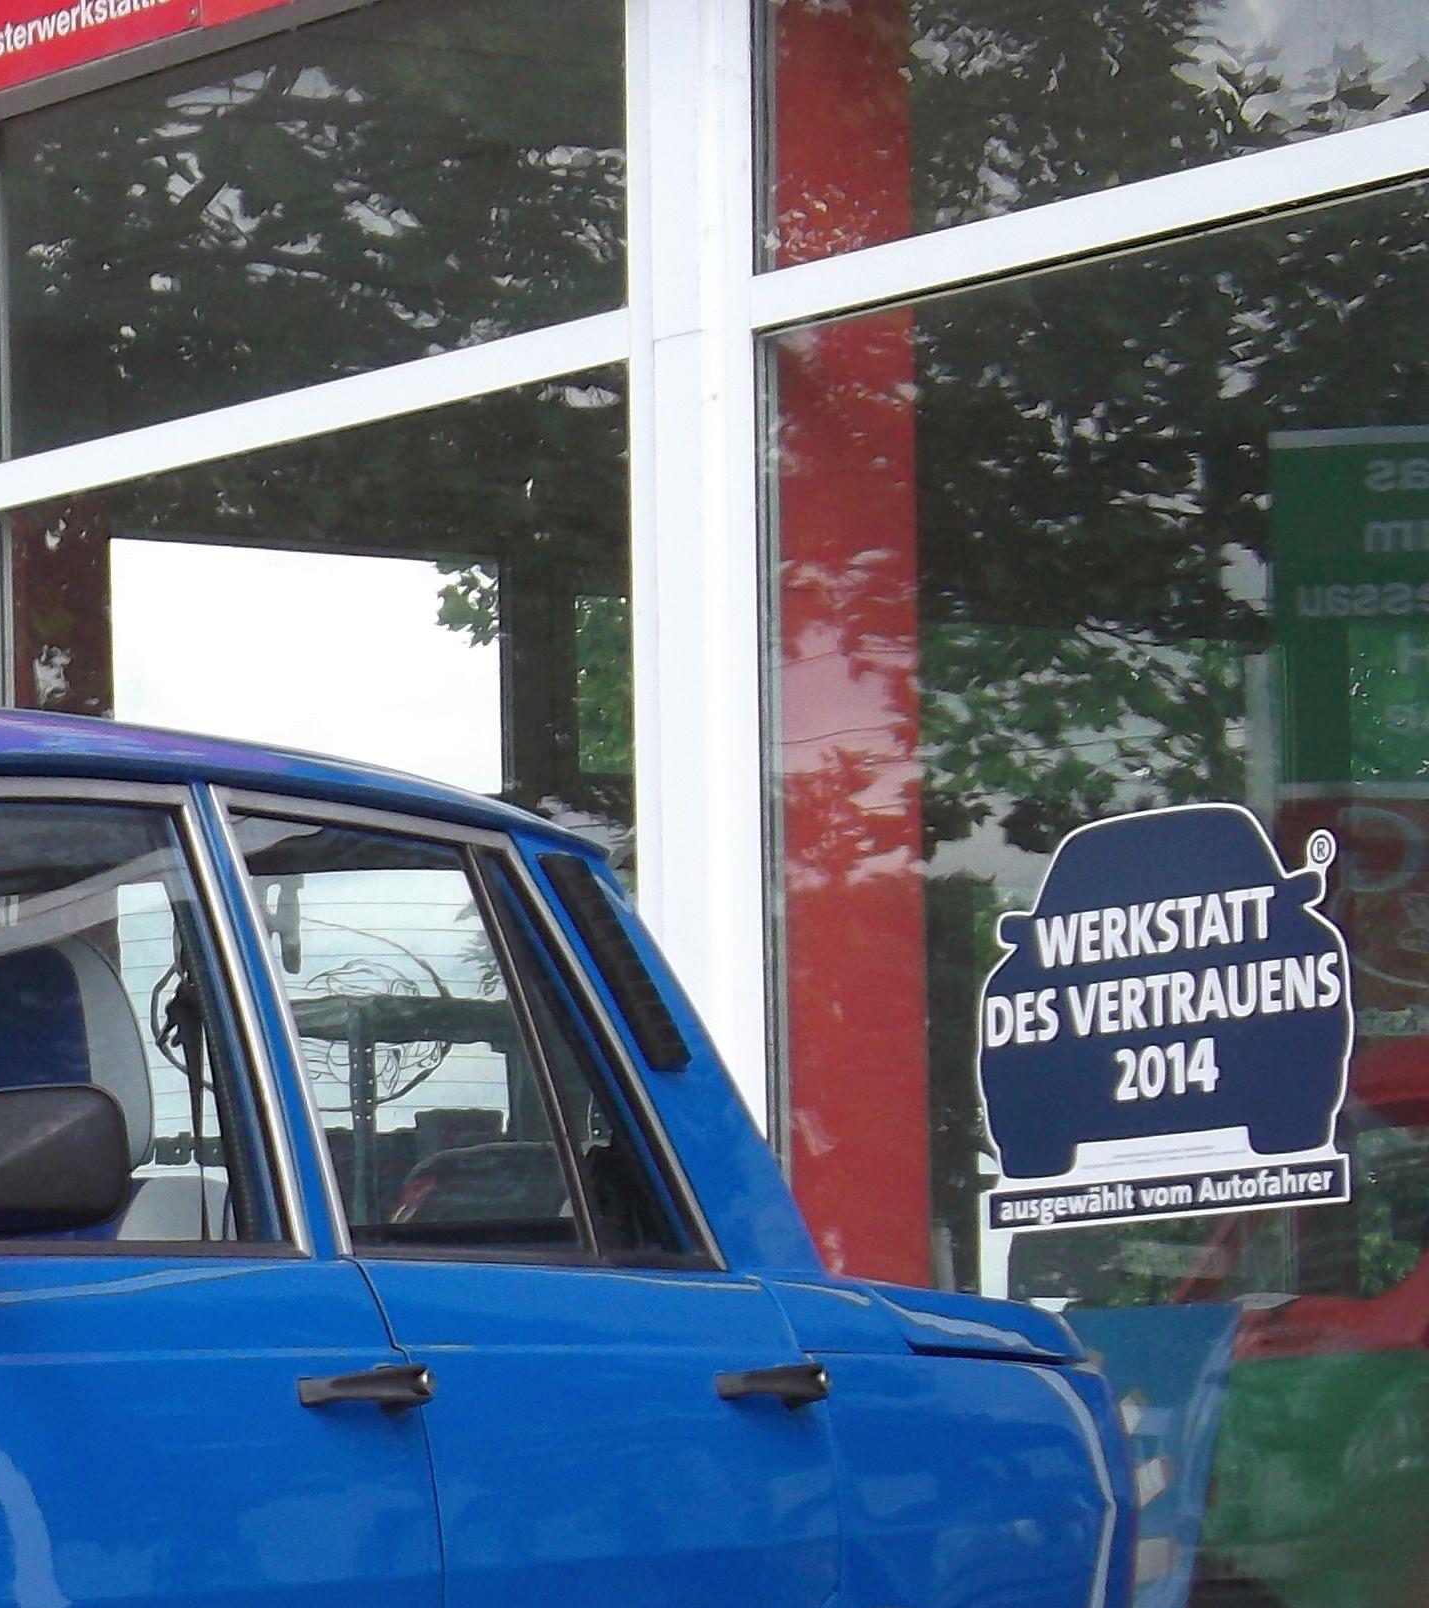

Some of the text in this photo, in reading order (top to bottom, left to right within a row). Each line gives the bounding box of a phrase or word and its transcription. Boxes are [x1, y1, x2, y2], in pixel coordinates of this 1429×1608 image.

[1036, 886, 1275, 969] WERKSTATT
[987, 987, 1060, 1048] DES
[1067, 952, 1342, 1036] VERTRAUENS
[1114, 1037, 1219, 1102] 2014
[999, 1167, 1333, 1225] ausgewählt vom Autofahrer
